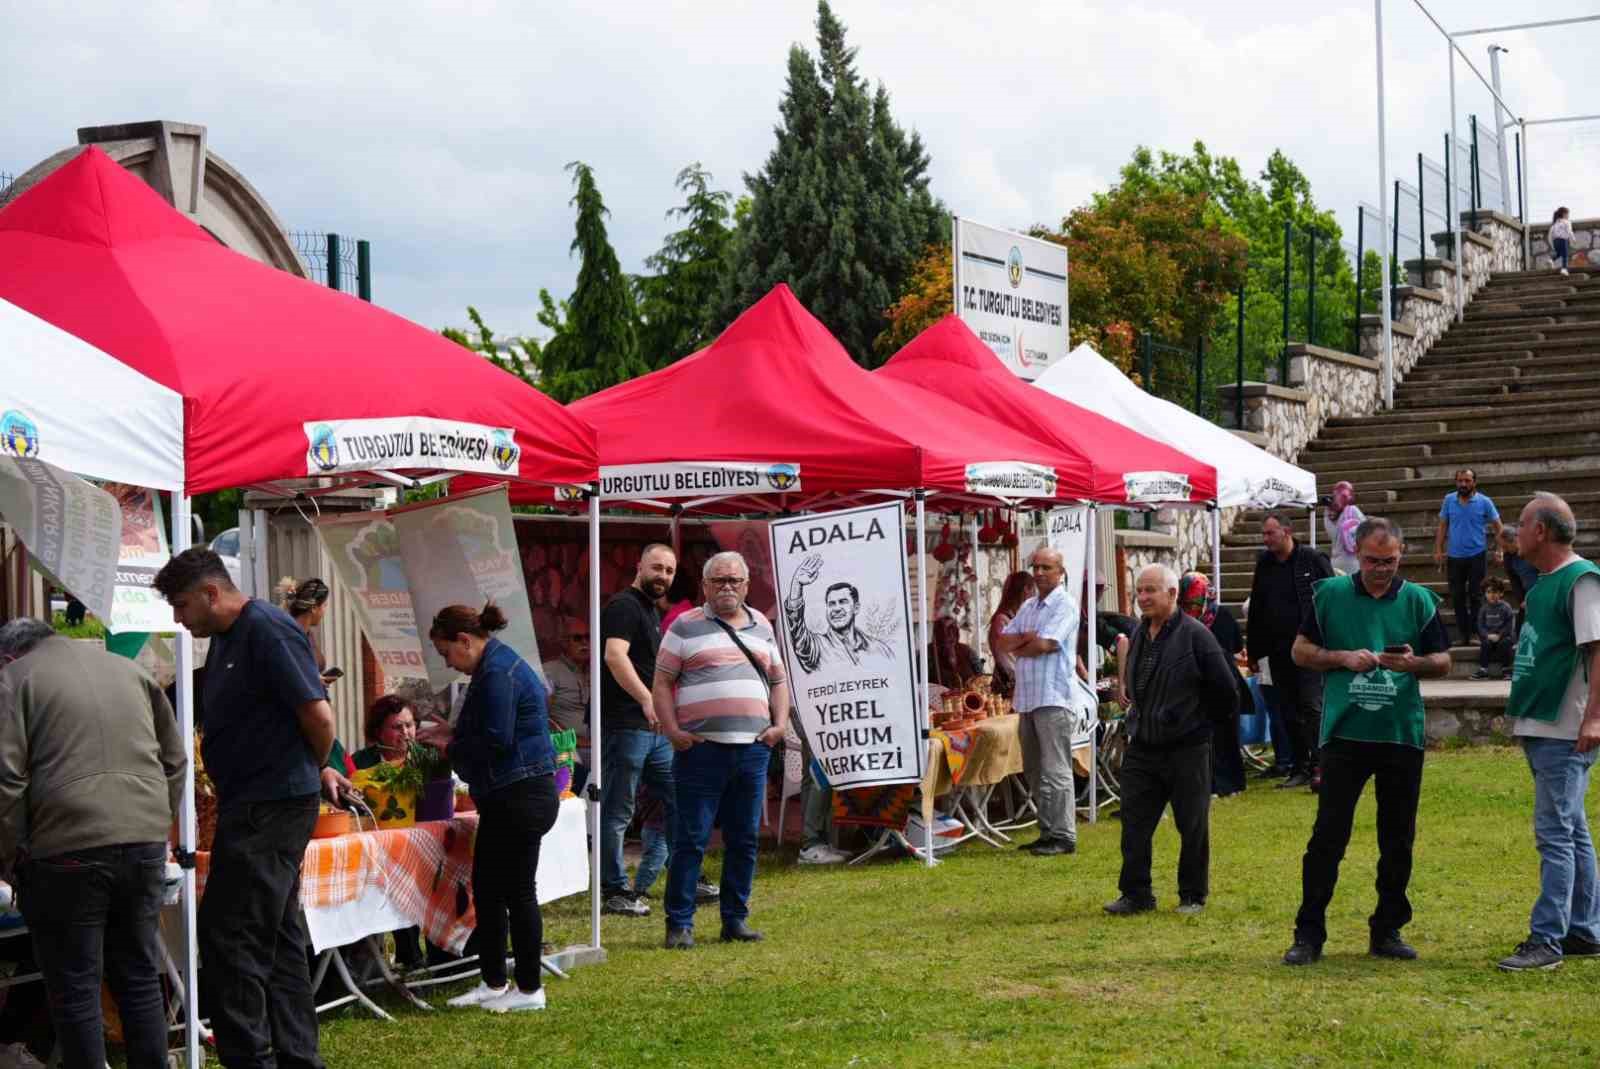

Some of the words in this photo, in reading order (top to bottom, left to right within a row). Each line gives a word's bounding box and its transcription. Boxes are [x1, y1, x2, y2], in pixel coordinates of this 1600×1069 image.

[963, 286, 977, 310] T.C.
[979, 288, 1020, 318] TURGUTLU
[1021, 298, 1062, 327] BELEDİYESİ
[675, 466, 760, 490] BELEDİYESİ
[788, 517, 886, 555] ADALA
[807, 679, 838, 700] FERDİ
[839, 677, 889, 694] ZEYREK
[815, 699, 885, 727] YEREL
[815, 726, 893, 753] TOHUM
